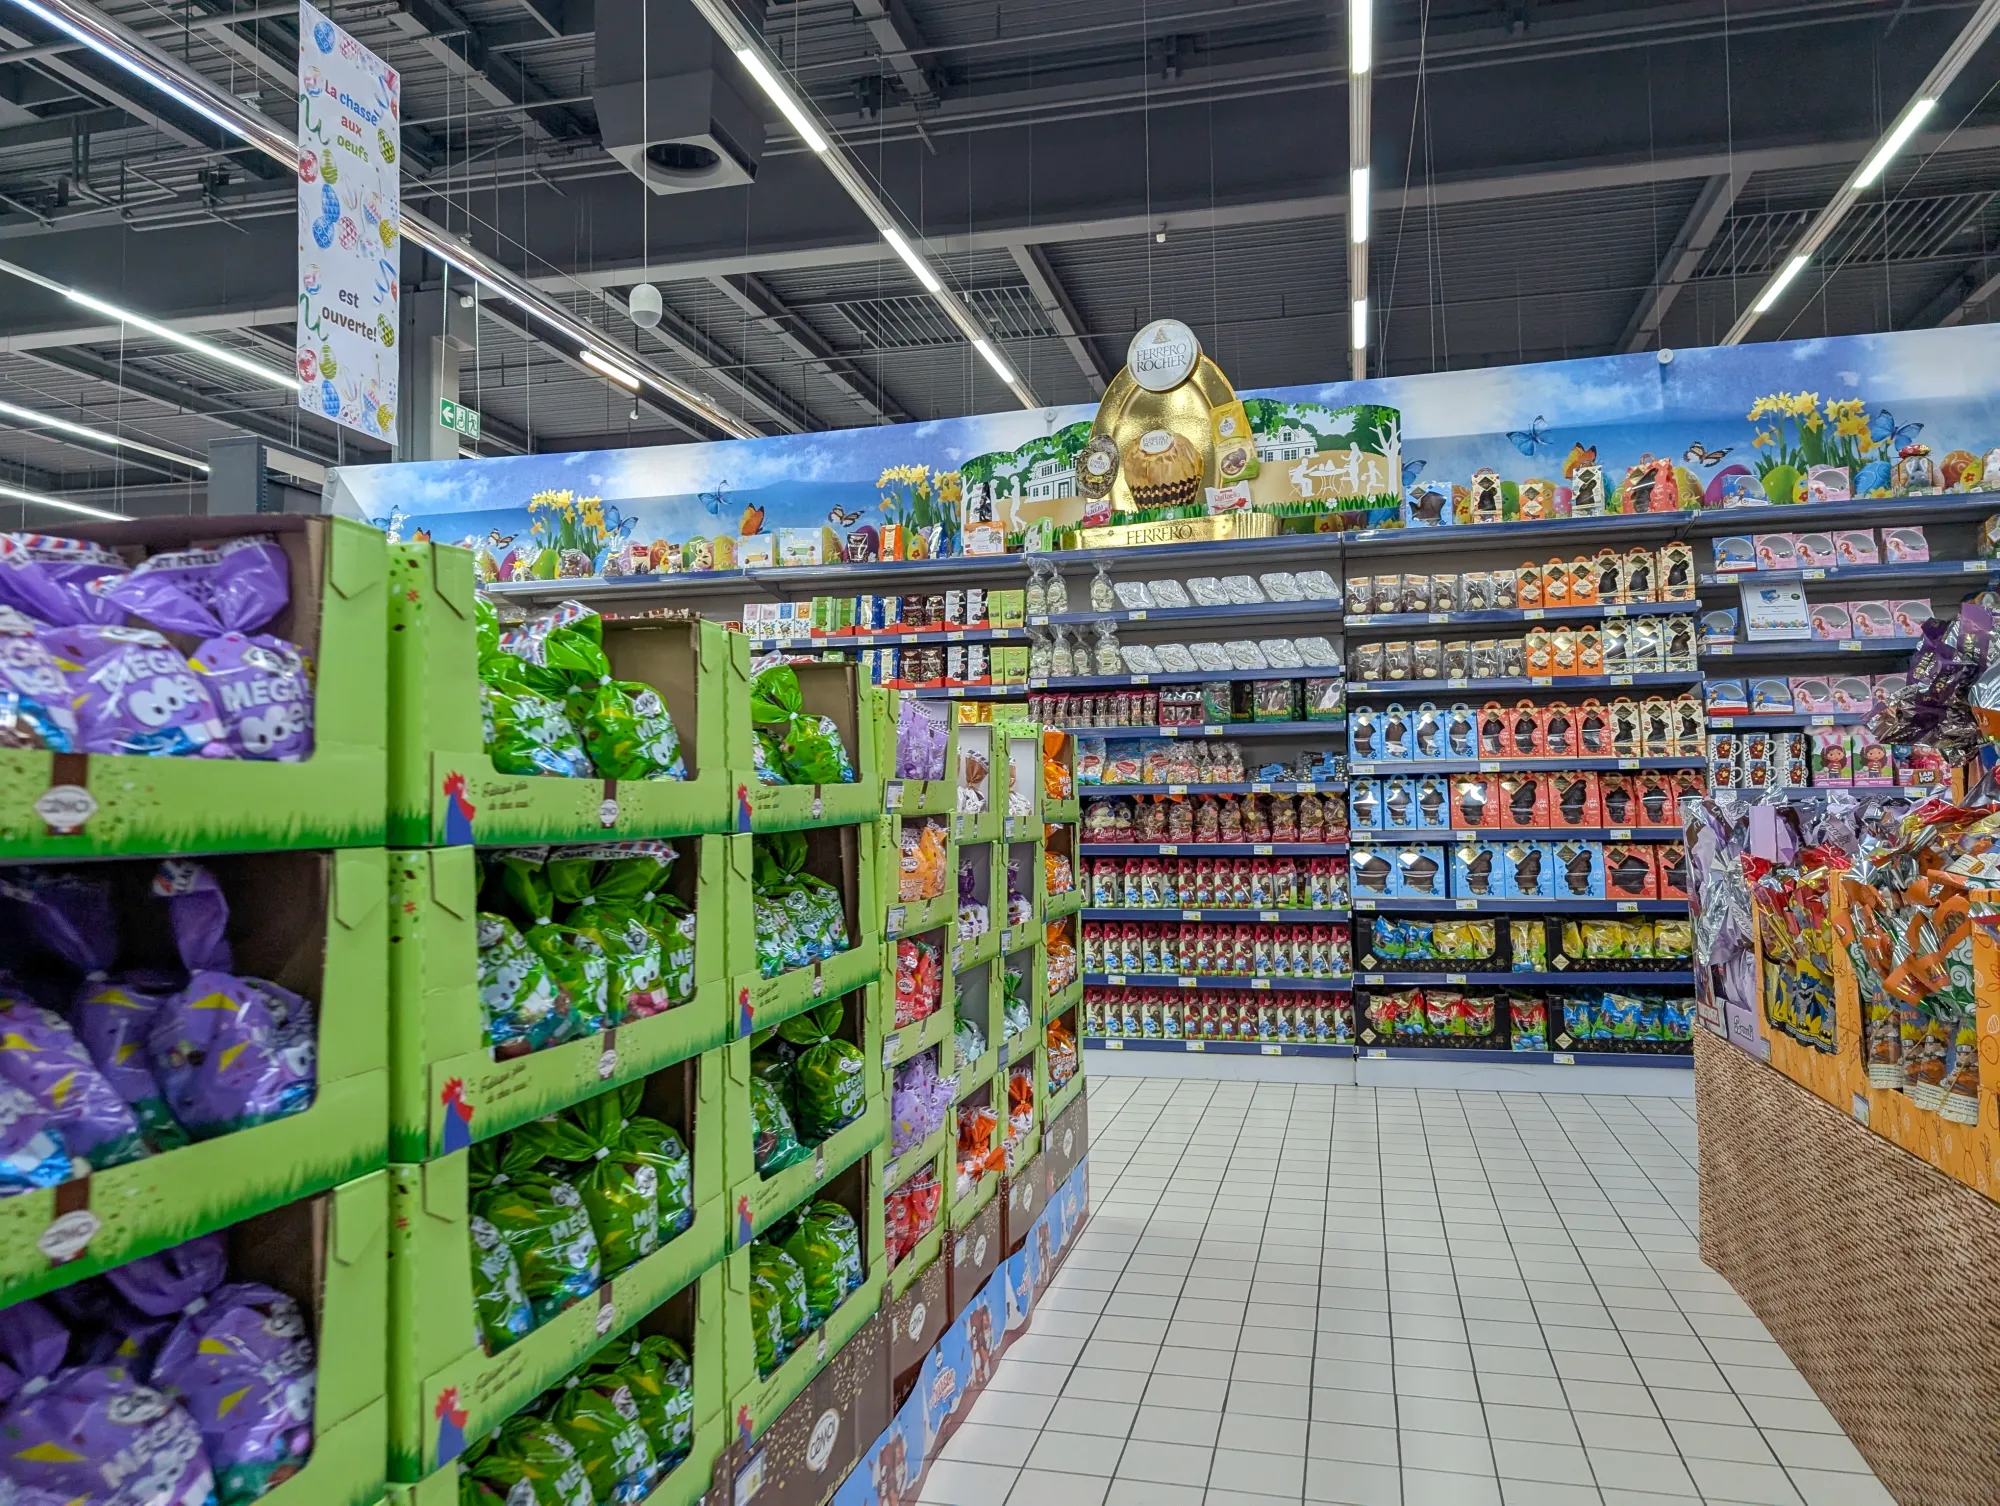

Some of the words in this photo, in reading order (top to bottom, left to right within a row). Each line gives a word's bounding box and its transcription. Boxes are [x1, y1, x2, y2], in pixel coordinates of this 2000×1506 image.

[324, 79, 338, 100] La
[339, 93, 378, 127] chasse
[340, 115, 362, 138] aux
[336, 134, 369, 163] oeufs
[338, 289, 359, 309] est
[321, 306, 377, 343] ouverte!
[1136, 343, 1187, 362] FERRERO
[1136, 355, 1187, 373] ROCHER
[1214, 491, 1240, 502] Raffaello
[1126, 524, 1193, 545] FERRERO
